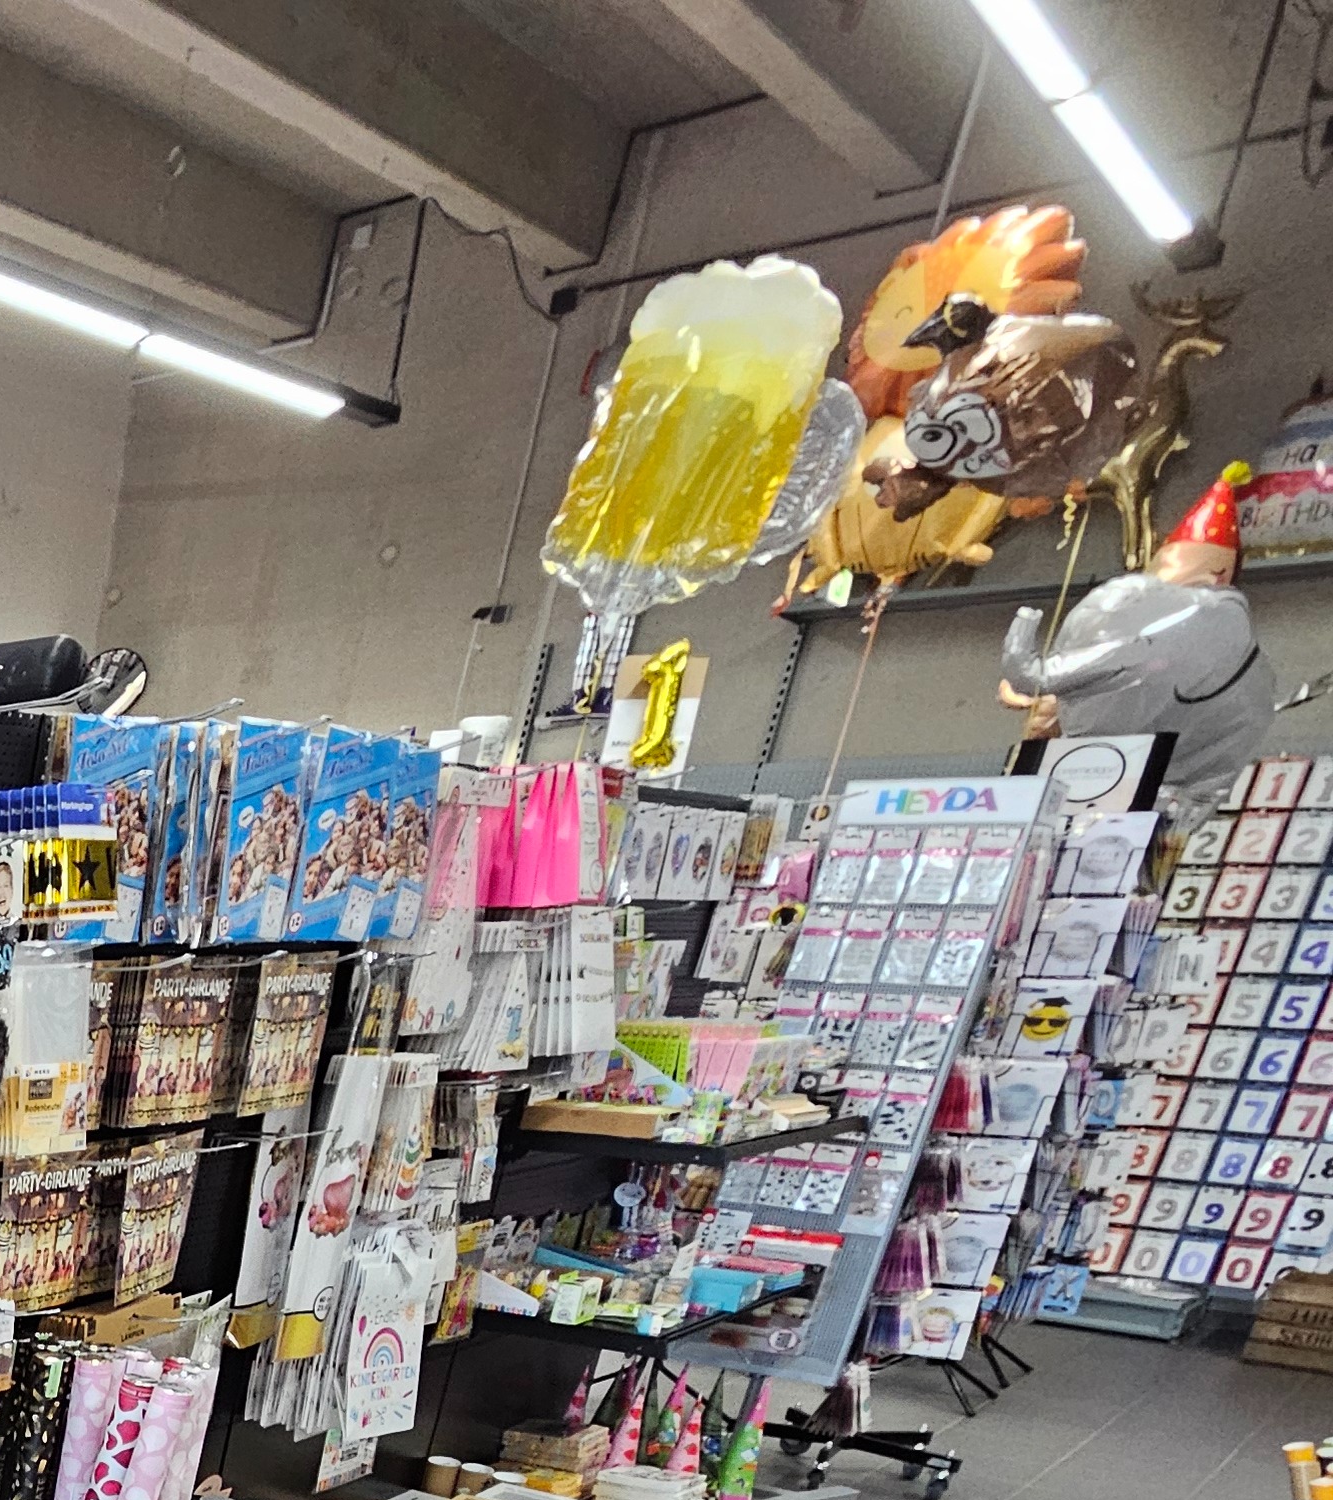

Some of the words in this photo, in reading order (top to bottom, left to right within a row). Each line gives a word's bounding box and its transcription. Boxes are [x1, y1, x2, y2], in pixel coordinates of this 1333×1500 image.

[875, 786, 998, 816] HEYDA
[1192, 830, 1219, 862] 2
[1177, 884, 1200, 914] 3
[1300, 940, 1331, 969] 4
[153, 976, 231, 999] PARTY-GIRLANDE
[266, 973, 332, 994] PARTY-GIRLANDE
[1279, 993, 1309, 1024] 5
[1257, 1047, 1285, 1076] 6
[1221, 1150, 1247, 1178] 8
[8, 1166, 93, 1196] PARTY-GIRLANDE
[1202, 1201, 1226, 1228] 9
[350, 1366, 417, 1389] KINDERGARTEN
